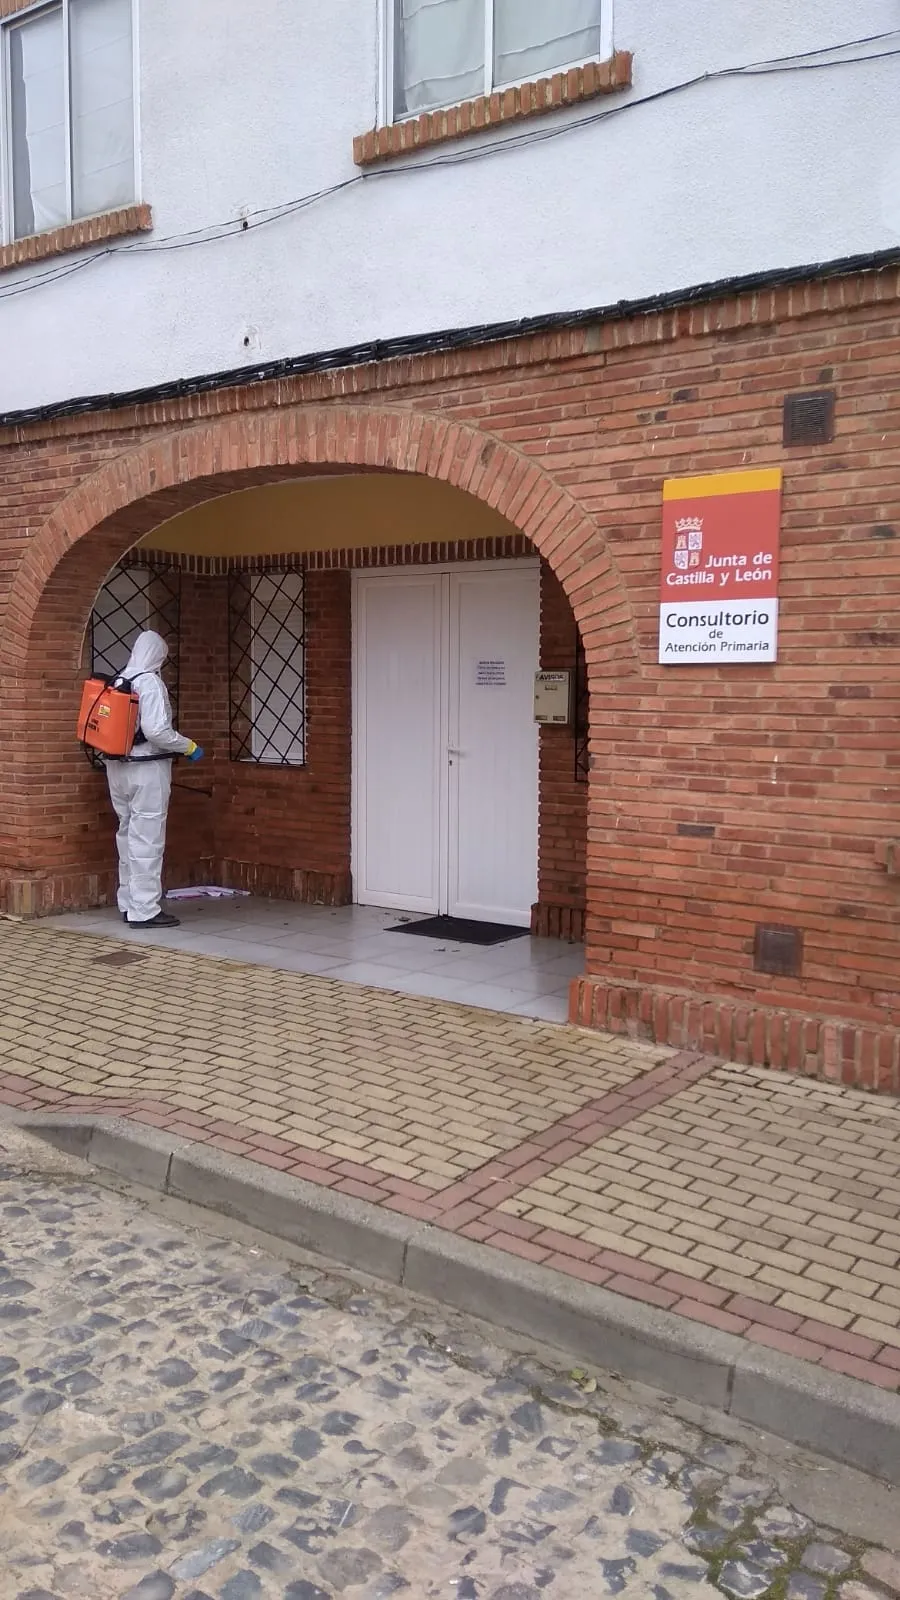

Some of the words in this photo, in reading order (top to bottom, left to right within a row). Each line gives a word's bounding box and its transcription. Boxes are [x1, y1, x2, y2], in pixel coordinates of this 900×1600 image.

[705, 554, 748, 568] Junta
[752, 551, 773, 565] de
[666, 571, 715, 585] Castilla
[719, 572, 730, 587] y
[735, 567, 772, 582] León
[666, 610, 770, 628] Consultorio
[708, 629, 724, 639] de
[664, 641, 717, 653] Atención
[720, 640, 770, 652] Primaria
